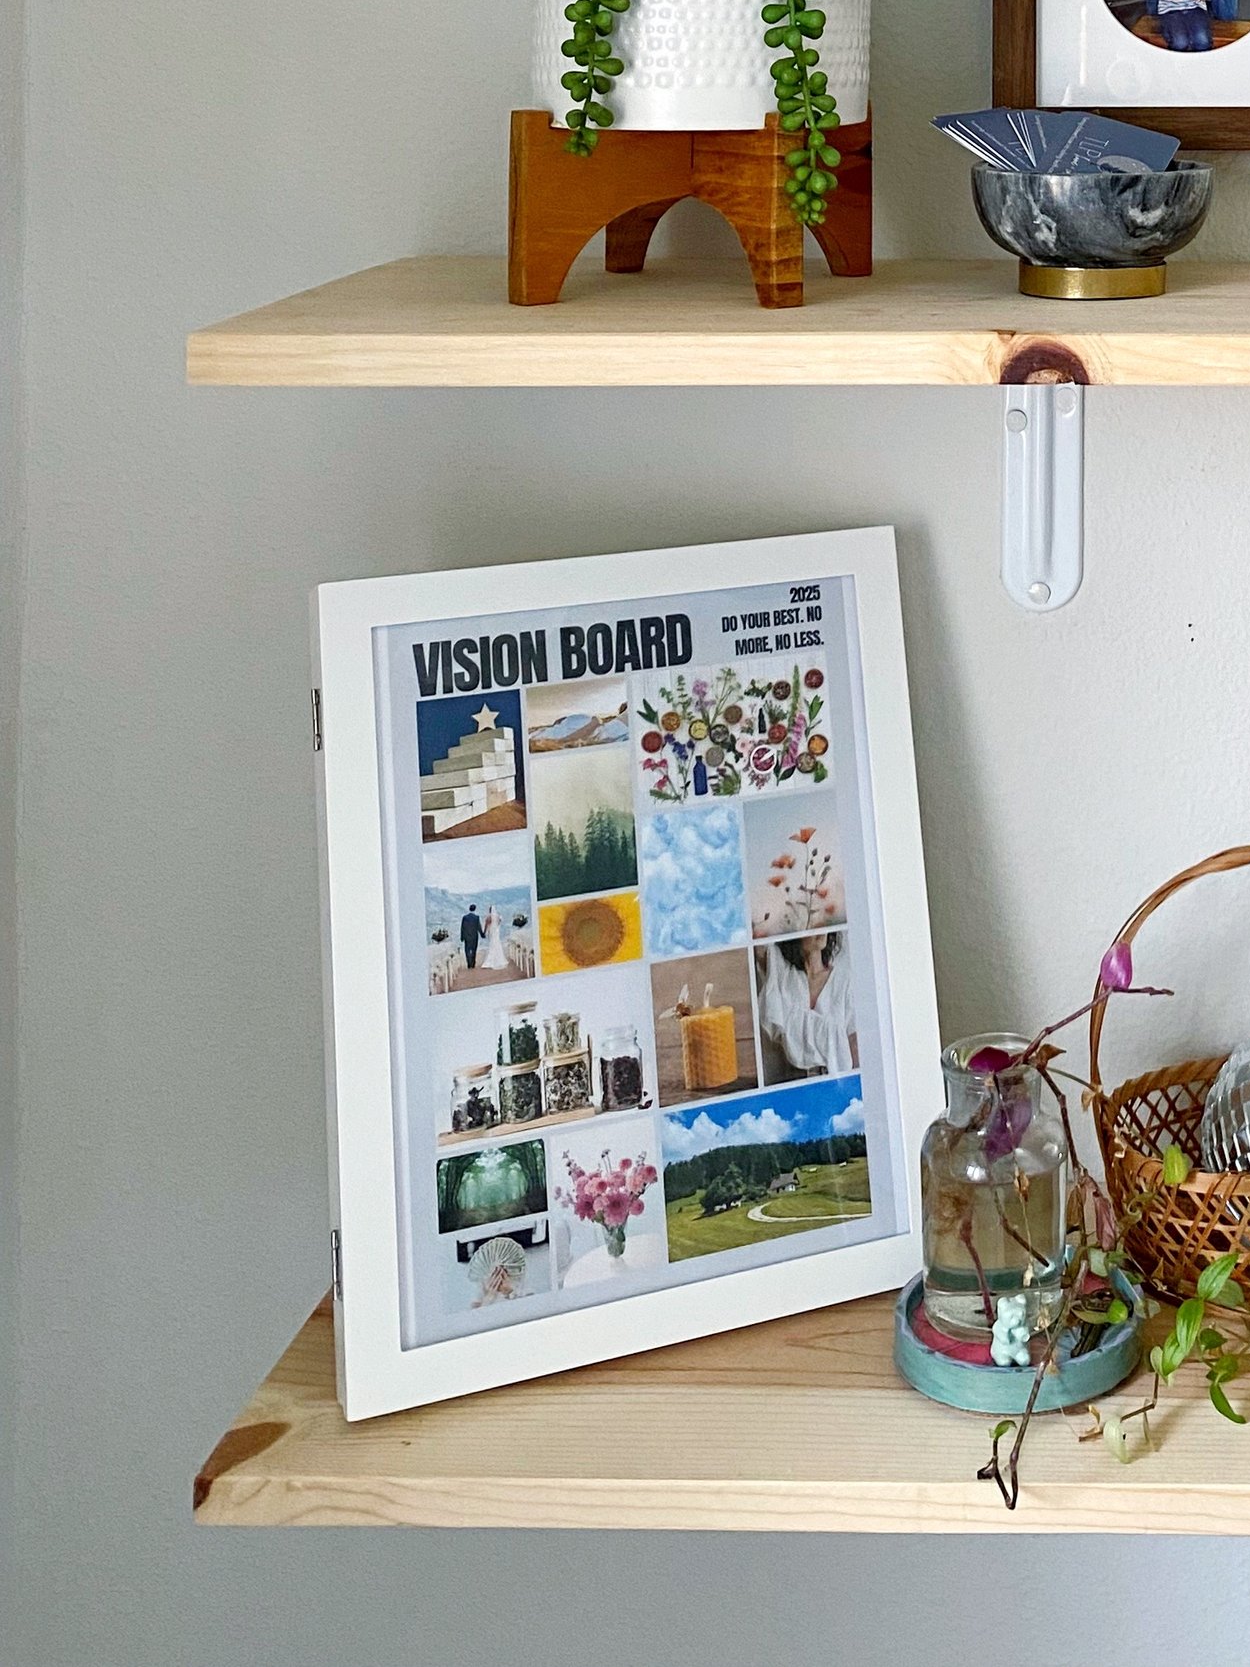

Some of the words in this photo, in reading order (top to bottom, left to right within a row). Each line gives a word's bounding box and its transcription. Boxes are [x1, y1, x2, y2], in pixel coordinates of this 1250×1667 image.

[789, 585, 821, 603] 2025
[722, 616, 738, 632] DO
[739, 611, 772, 631] YOUR
[773, 608, 805, 627] BEST.
[806, 605, 823, 622] NO
[413, 629, 547, 697] VISION
[560, 613, 693, 679] BOARD
[735, 636, 774, 656] MORE,
[775, 633, 793, 650] NO
[794, 629, 826, 649] LESS.
